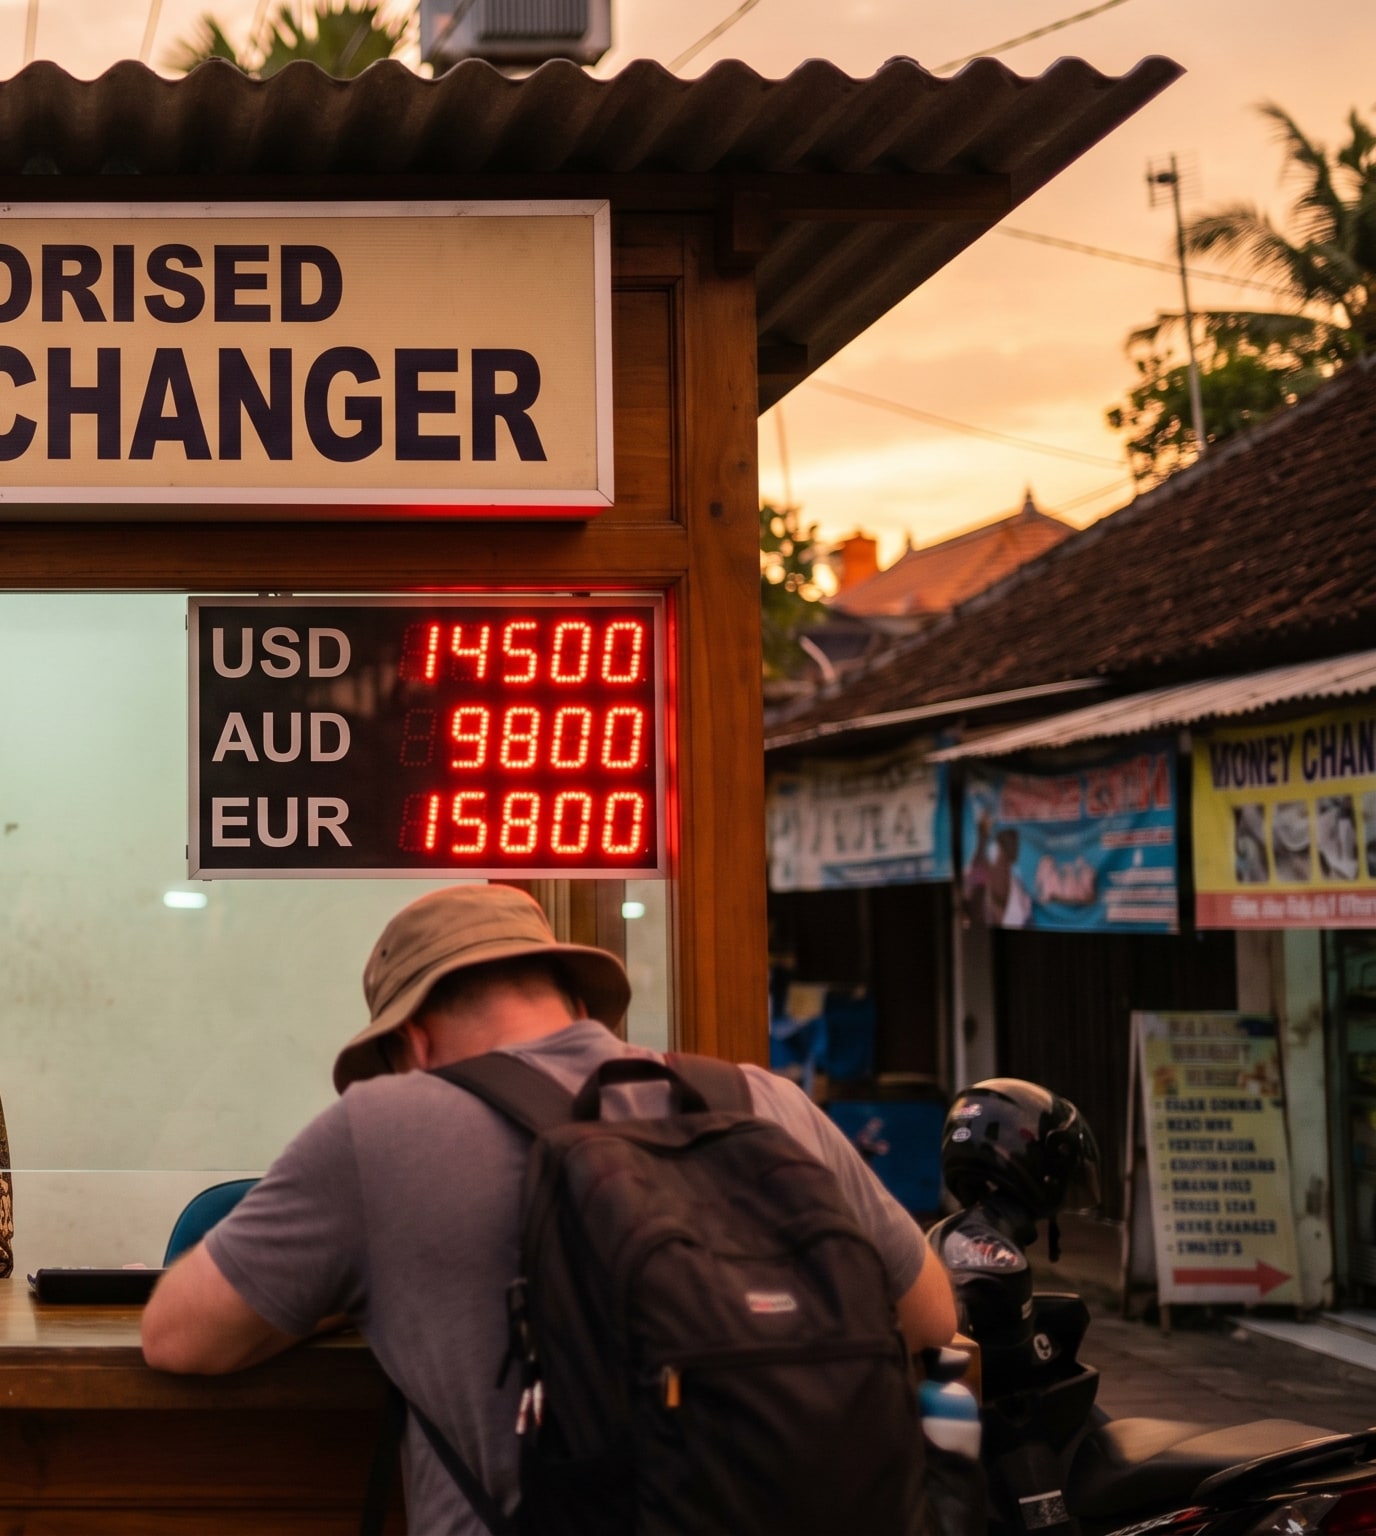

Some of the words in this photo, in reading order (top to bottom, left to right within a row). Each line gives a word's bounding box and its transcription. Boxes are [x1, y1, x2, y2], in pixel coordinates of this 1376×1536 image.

[212, 627, 351, 678] USD
[425, 621, 643, 683] 14500
[212, 712, 351, 763] AUD
[452, 706, 643, 769] 9800
[1209, 733, 1295, 788] MONEY
[211, 797, 352, 848] EUR
[425, 791, 643, 854] 15800
